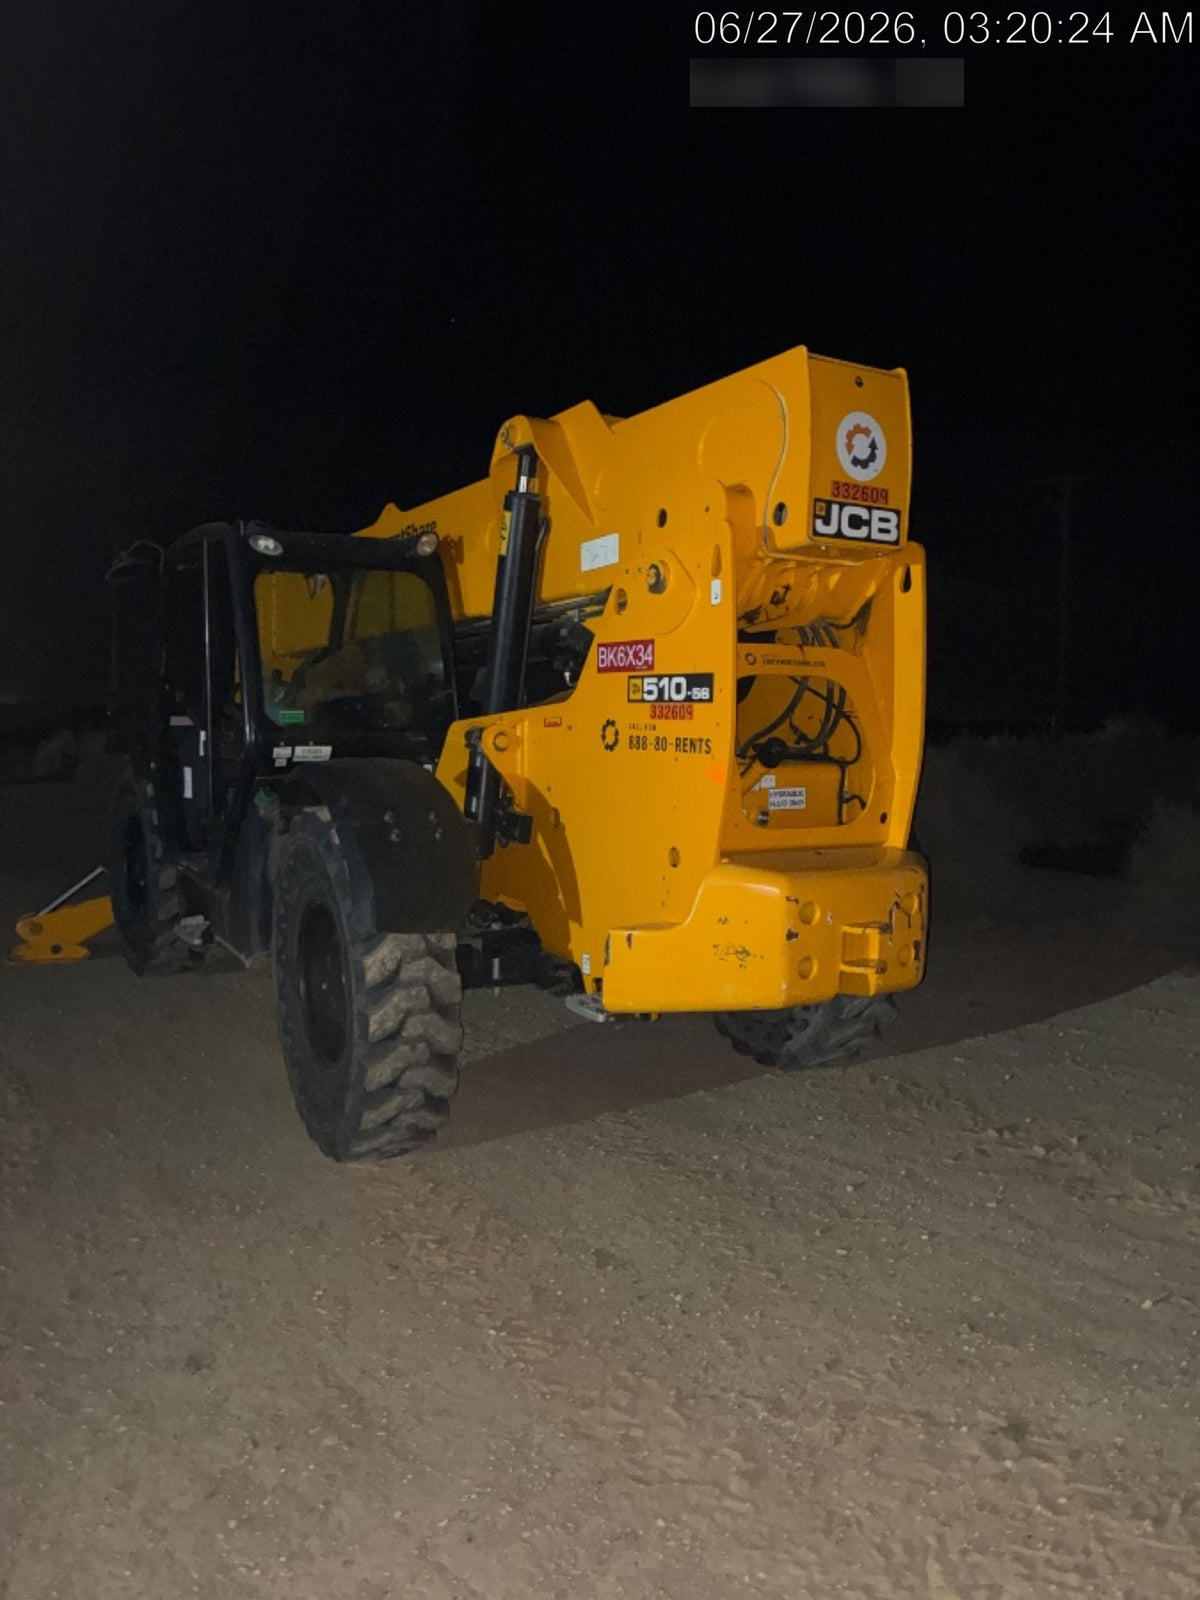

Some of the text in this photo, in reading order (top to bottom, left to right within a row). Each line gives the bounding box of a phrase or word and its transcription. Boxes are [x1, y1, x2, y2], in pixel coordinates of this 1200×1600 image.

[831, 481, 889, 505] 332609
[815, 503, 899, 542] JCB
[598, 644, 653, 668] BK6X34
[650, 704, 694, 720] 332609
